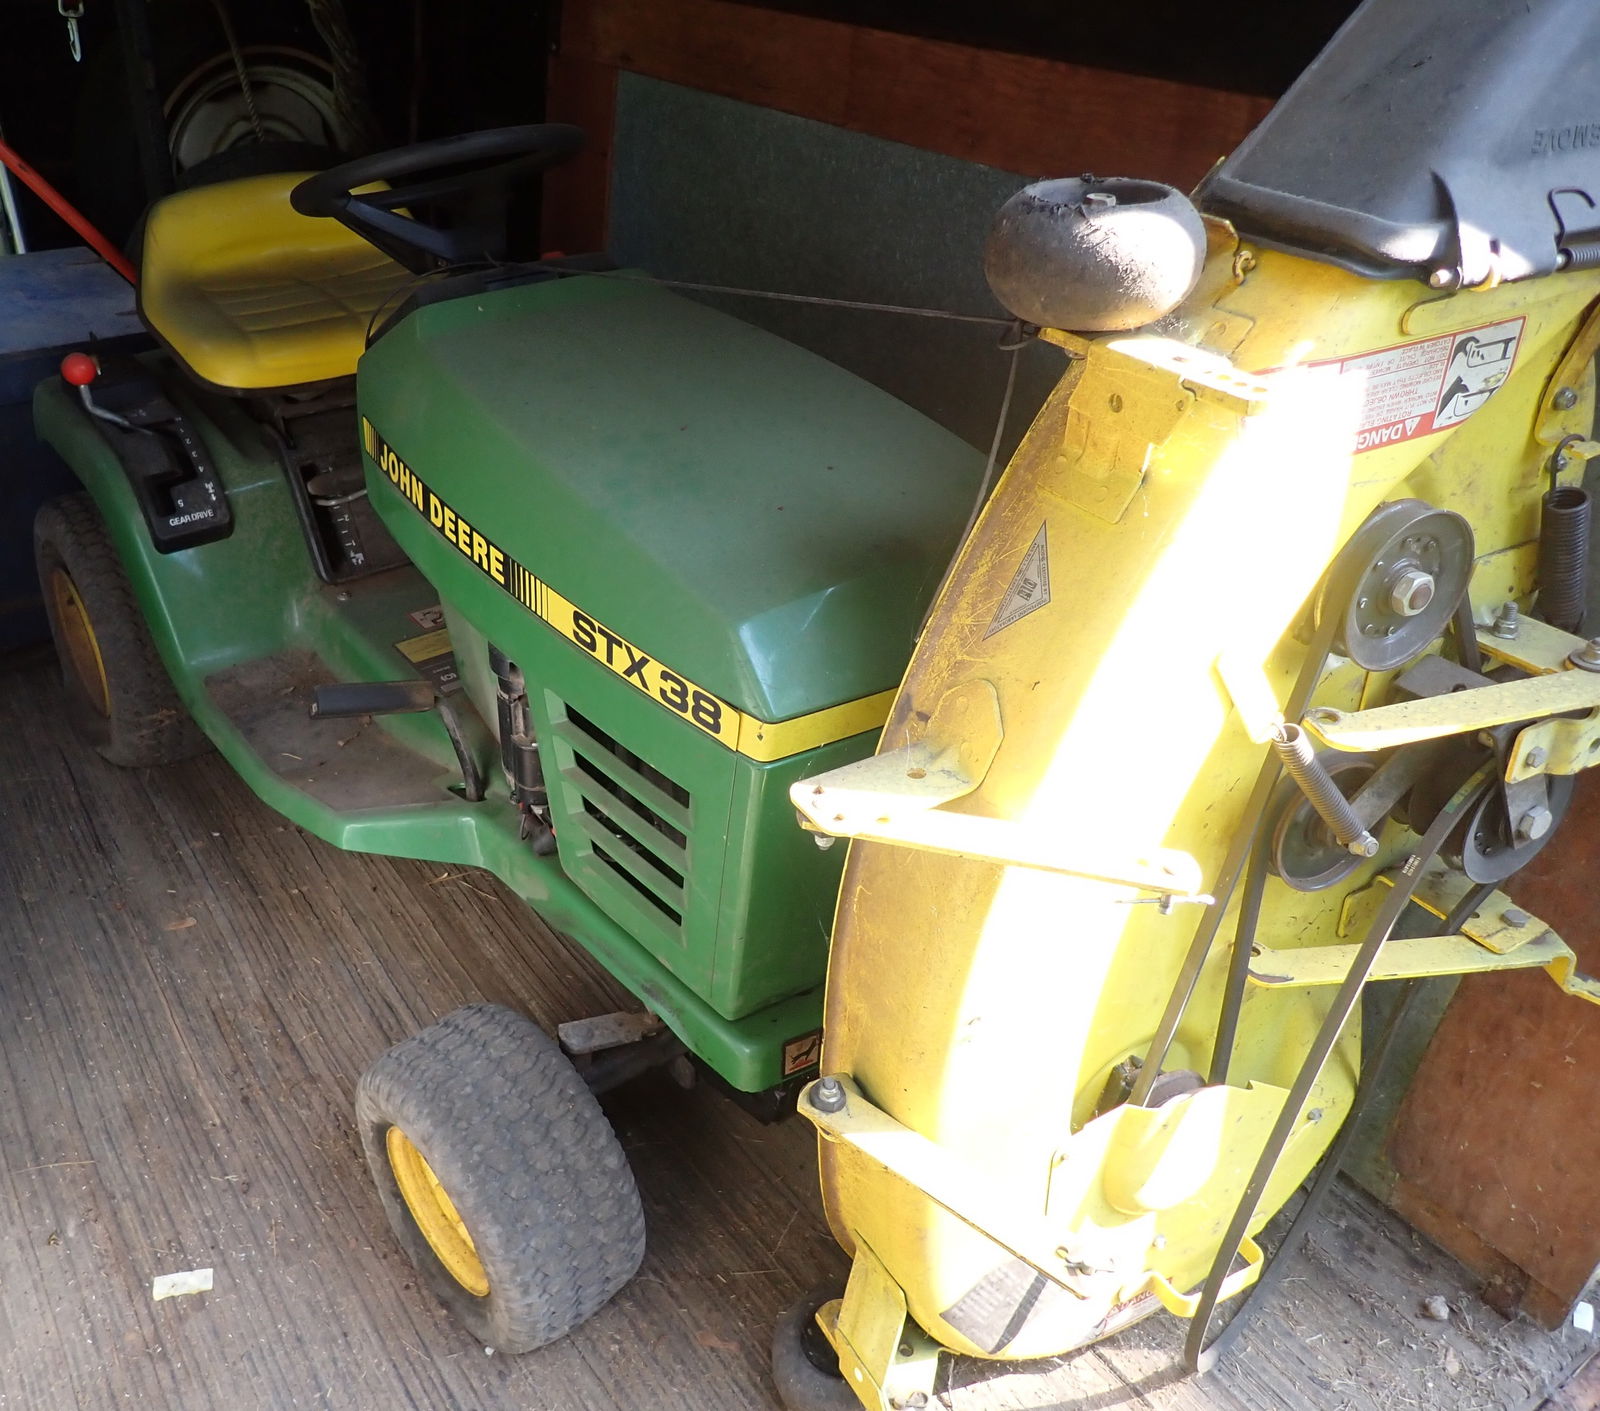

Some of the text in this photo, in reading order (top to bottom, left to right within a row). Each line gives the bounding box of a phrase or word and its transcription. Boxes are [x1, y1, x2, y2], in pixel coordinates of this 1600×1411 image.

[1363, 387, 1418, 407] THROWN OBJEC
[1375, 410, 1411, 424] ROTATING
[1354, 423, 1403, 450] DANG
[169, 508, 214, 527] GEAR DRIVE
[378, 442, 506, 585] JOHN DEERE
